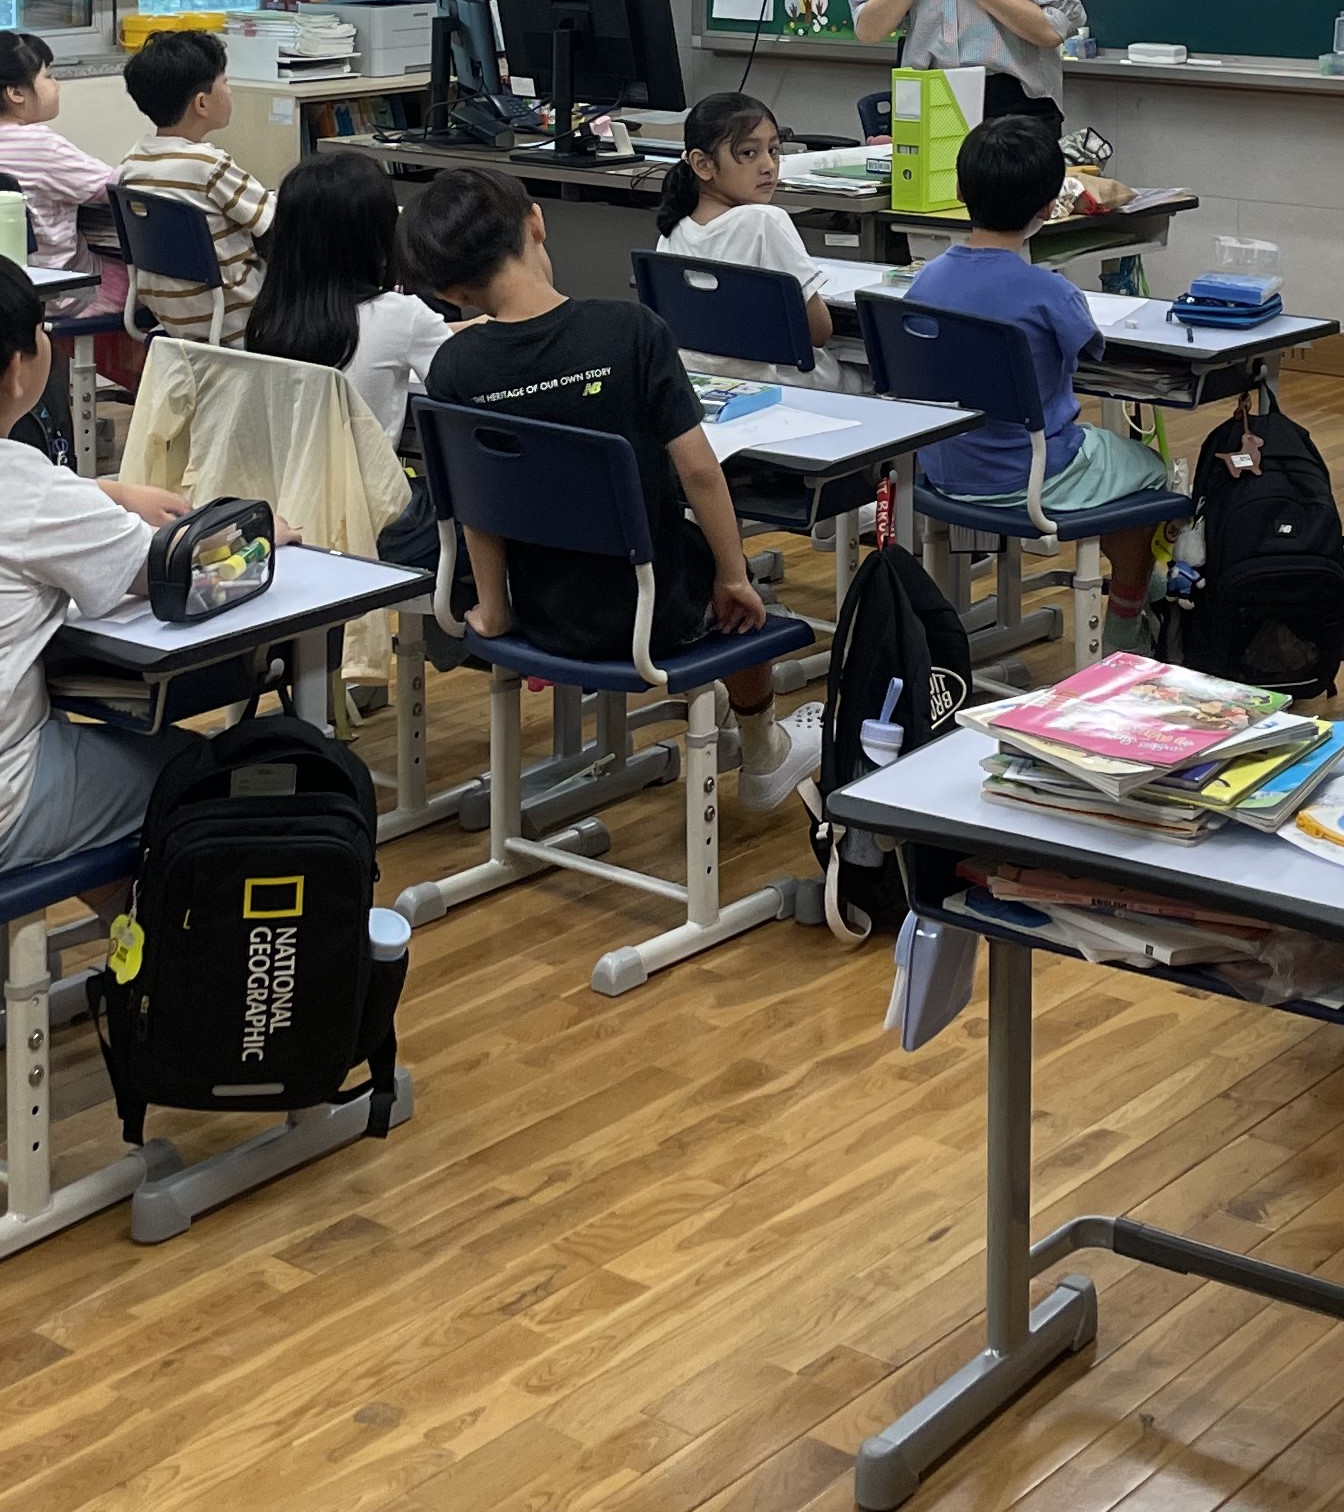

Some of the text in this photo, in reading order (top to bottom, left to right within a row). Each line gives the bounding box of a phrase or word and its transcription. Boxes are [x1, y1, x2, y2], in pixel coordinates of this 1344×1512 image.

[486, 386, 525, 402] HERITAGE
[526, 383, 538, 394] OF
[540, 378, 559, 391] OUR
[560, 372, 584, 386] OWN
[585, 366, 612, 380] STORY
[241, 925, 273, 1063] GEOGRAPHIC
[269, 926, 297, 1035] NATIONAL
